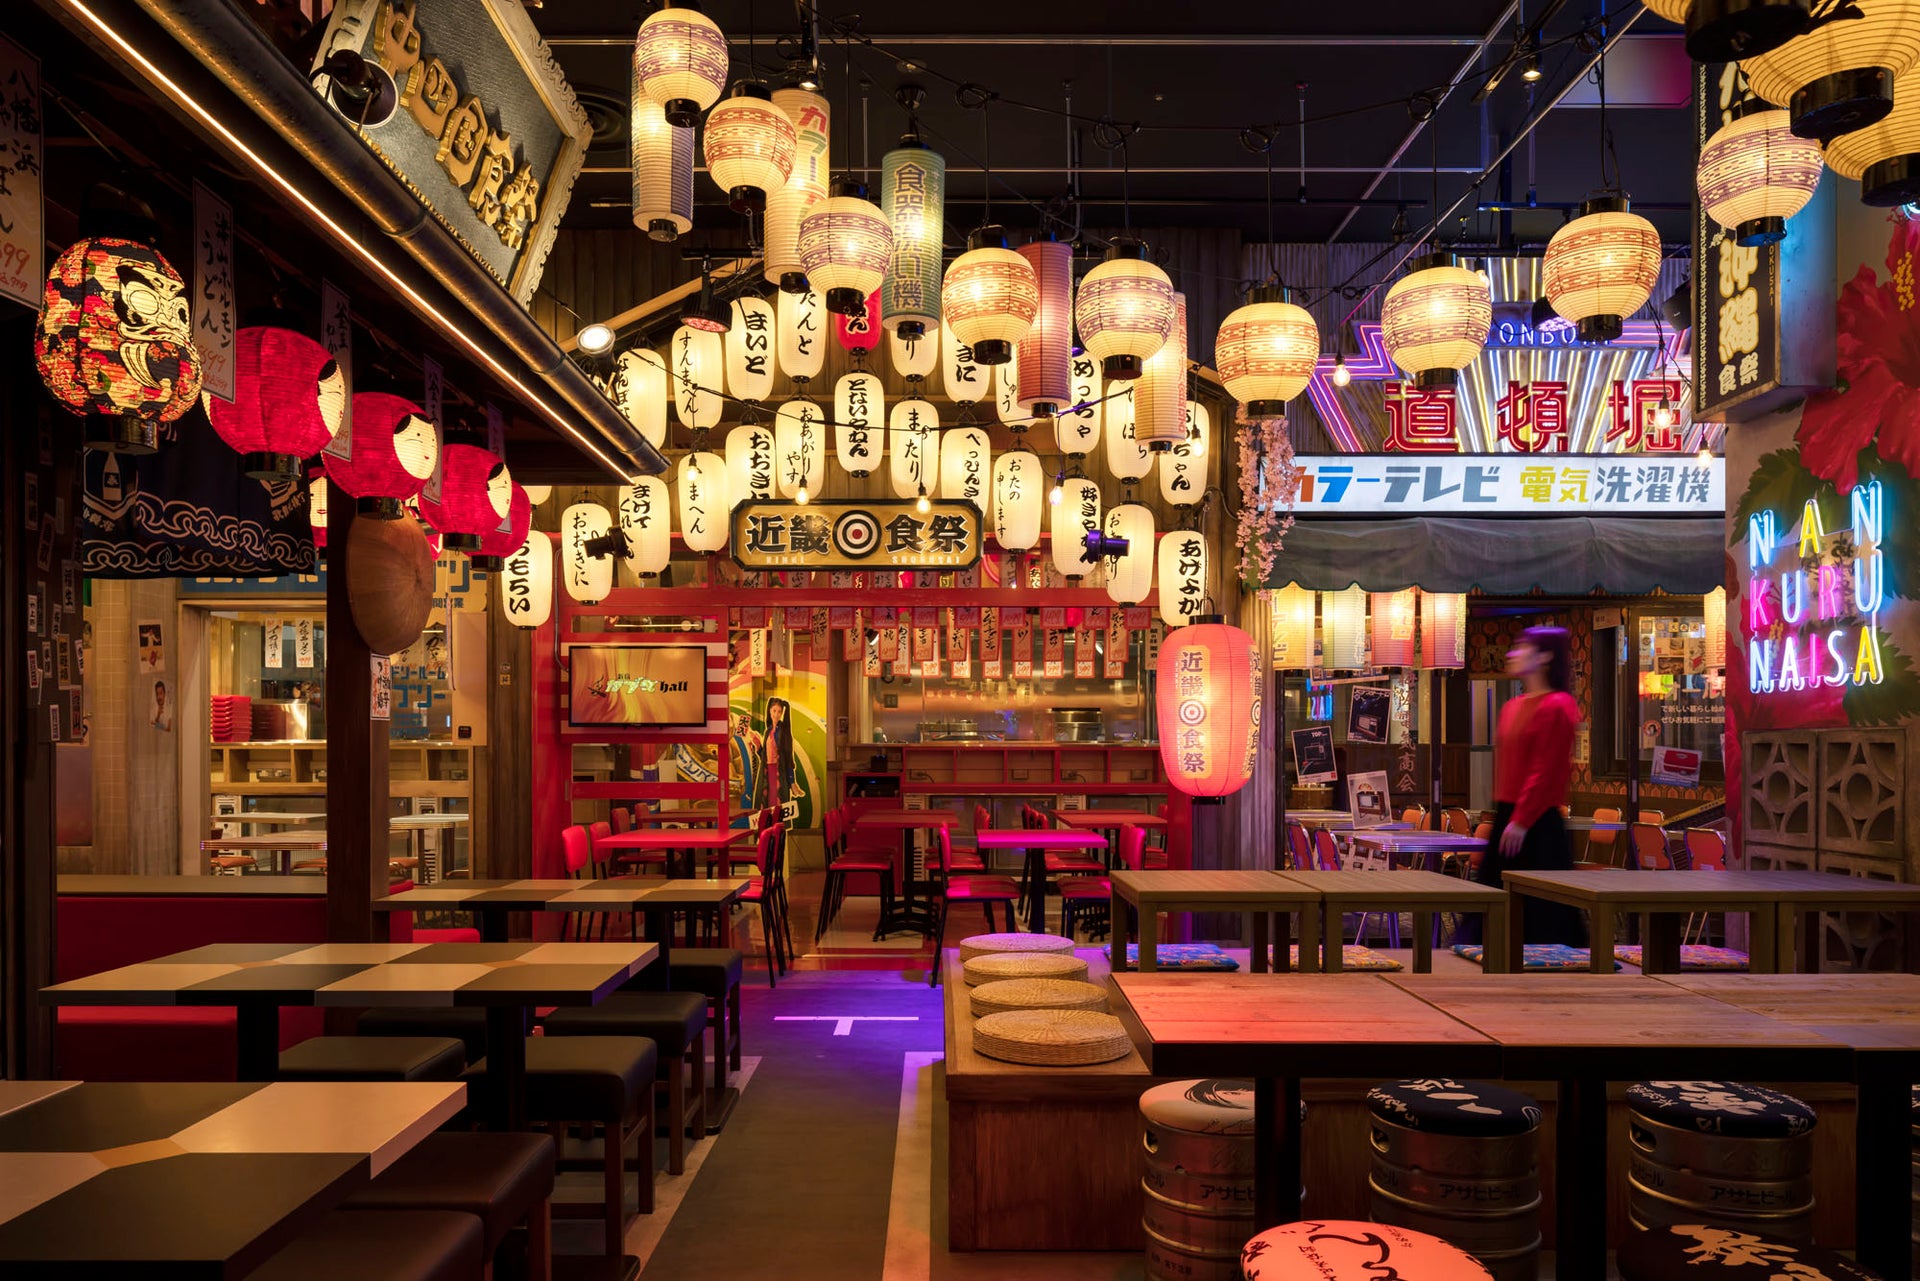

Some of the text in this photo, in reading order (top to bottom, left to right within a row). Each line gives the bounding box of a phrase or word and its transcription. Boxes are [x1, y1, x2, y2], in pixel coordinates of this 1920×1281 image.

[0, 242, 29, 275] 99
[848, 378, 869, 458] どないやねん
[1383, 380, 1682, 452] 道頓堀
[688, 467, 705, 534] まへん
[1009, 458, 1023, 501] おたの
[1519, 465, 1712, 503] 電気洗濯機
[572, 511, 590, 587] おおきに
[745, 513, 970, 555] 近畿 食祭
[1749, 480, 1883, 570] NAN
[1178, 539, 1202, 615] あげよか
[1749, 553, 1883, 632] KURU
[660, 681, 688, 694] hall
[1664, 682, 1726, 701] オール
[1749, 626, 1884, 694] NAISA
[1180, 651, 1206, 773] 近畿 食祭
[1439, 1183, 1521, 1203] アサヒビール
